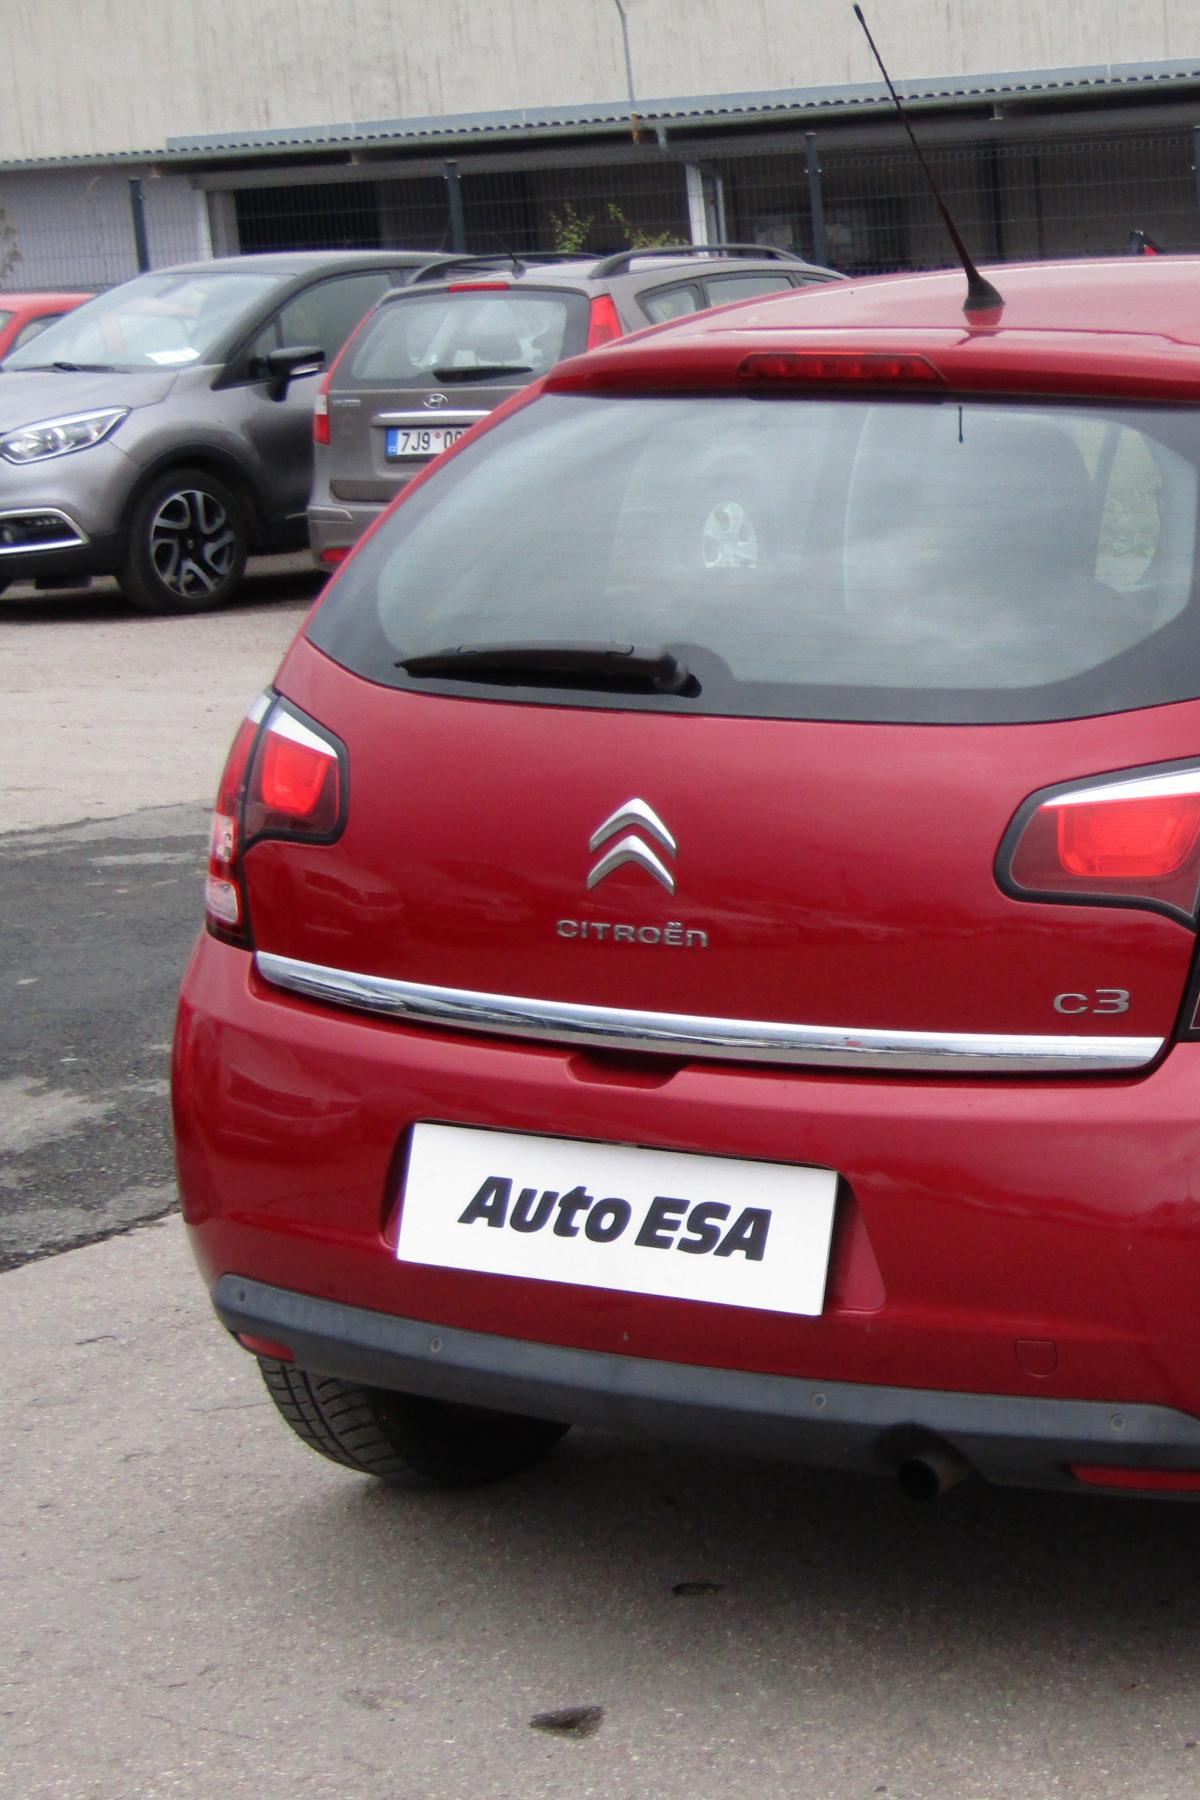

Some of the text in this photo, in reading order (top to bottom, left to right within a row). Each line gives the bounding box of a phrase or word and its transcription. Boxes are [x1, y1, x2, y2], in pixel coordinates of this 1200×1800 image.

[401, 431, 431, 452] 7J9
[457, 1175, 772, 1262] Auto ESA
